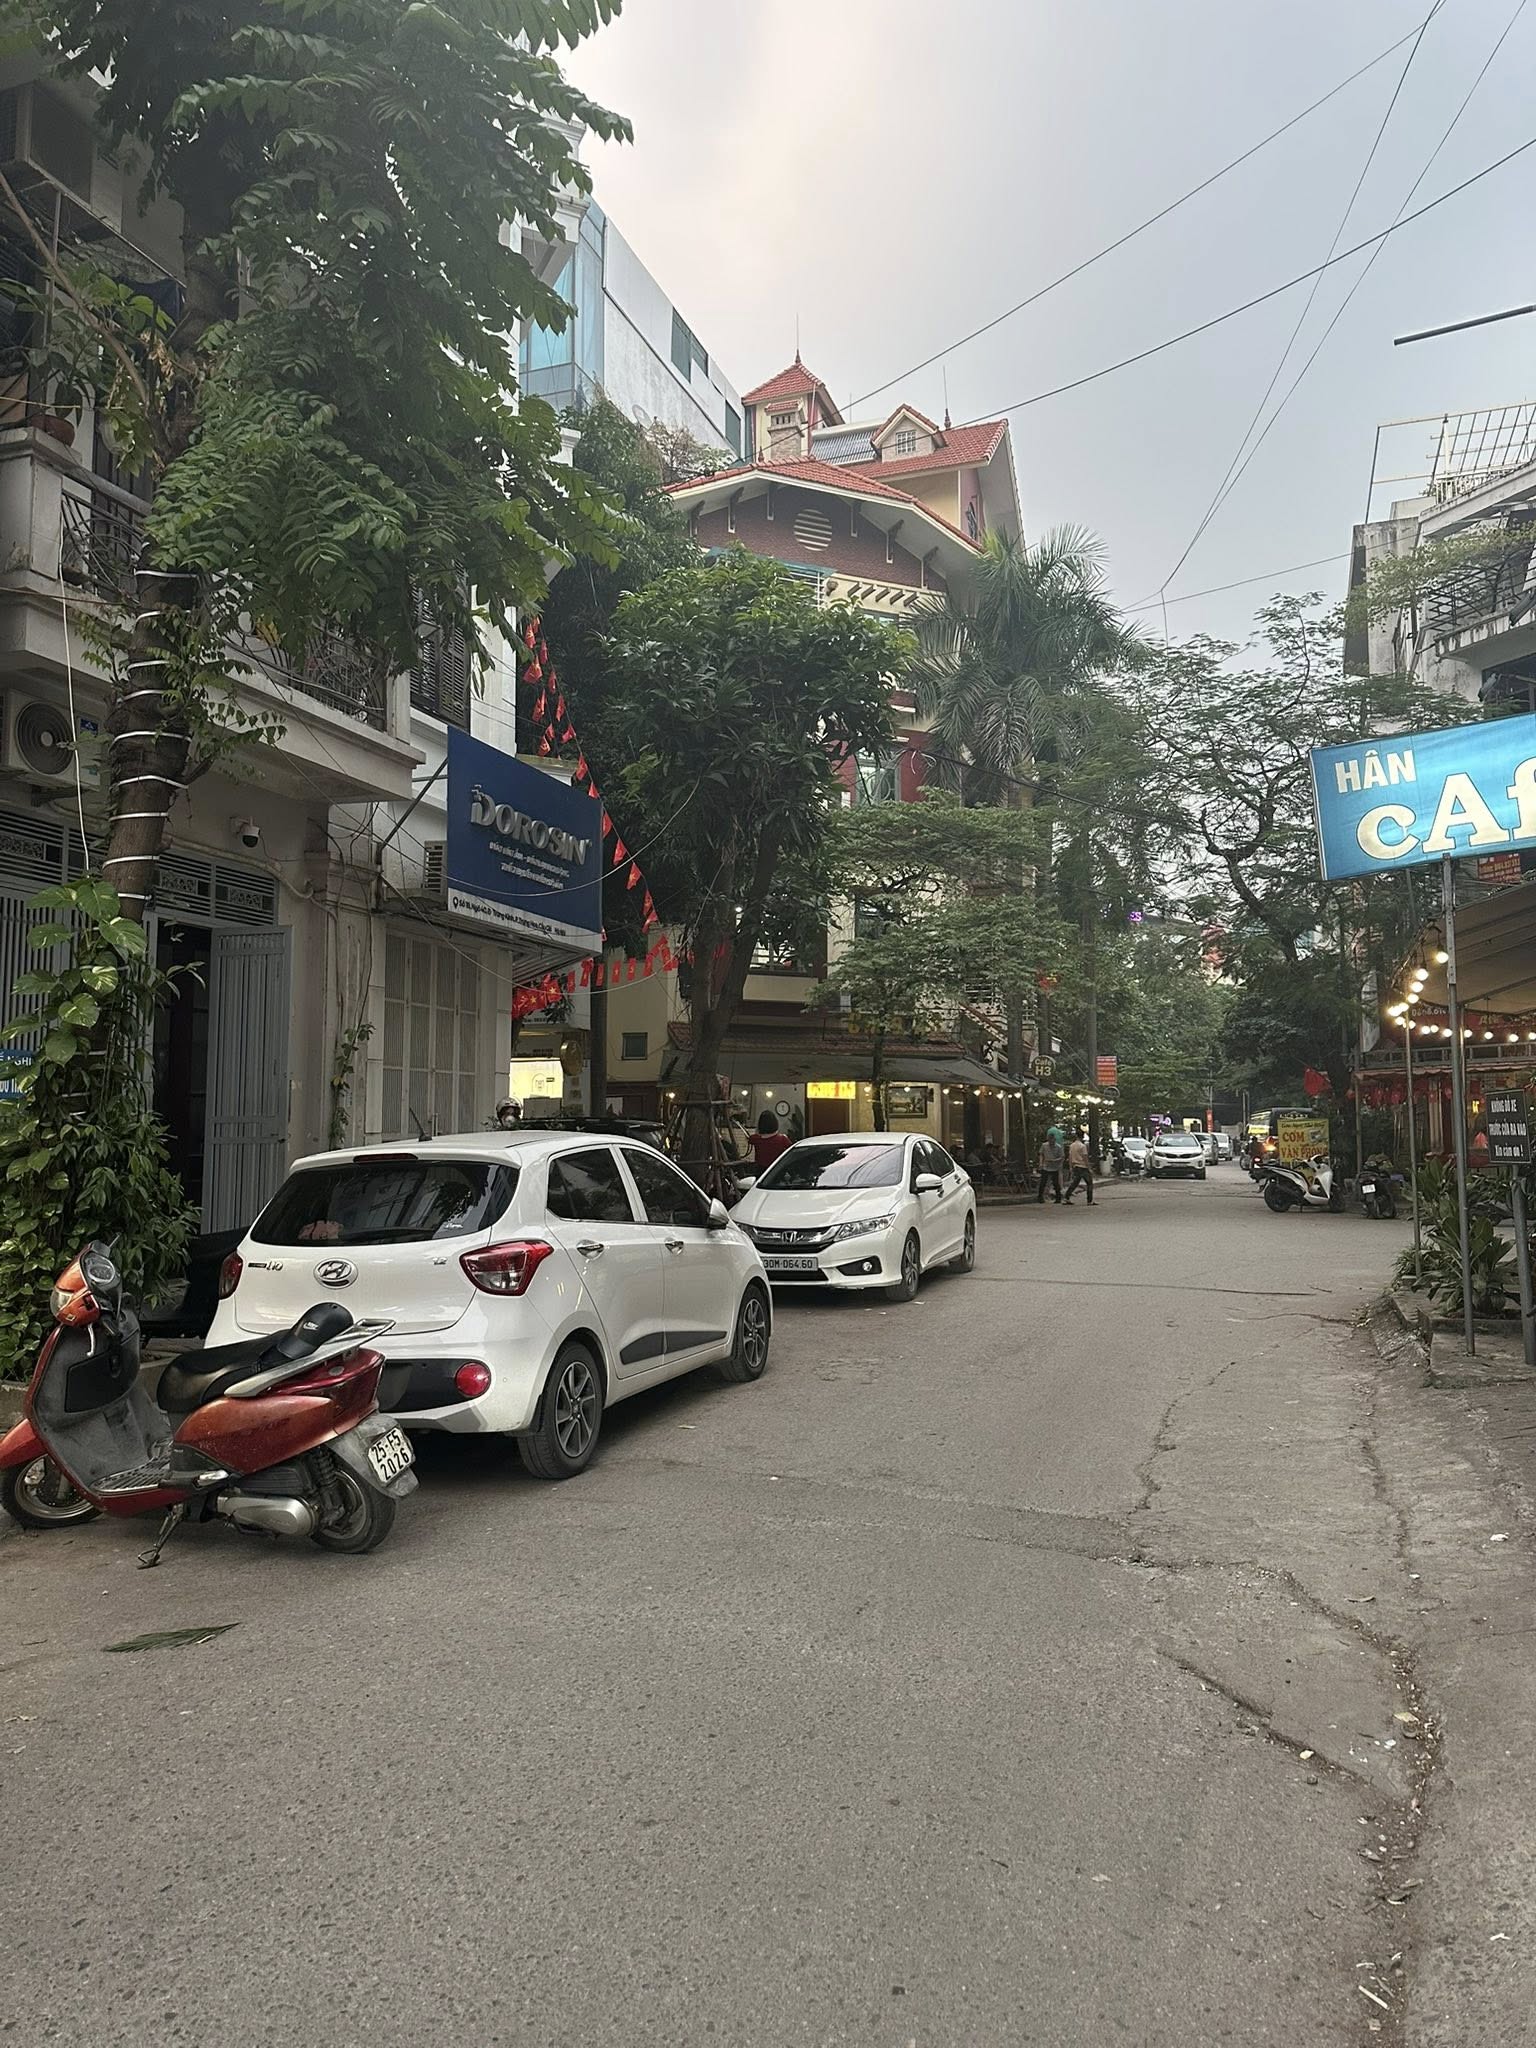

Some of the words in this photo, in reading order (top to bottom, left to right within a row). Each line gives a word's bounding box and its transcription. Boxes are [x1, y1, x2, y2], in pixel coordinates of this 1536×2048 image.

[1335, 750, 1417, 793] HÂN
[471, 784, 586, 865] DOROSIN
[1035, 1066, 1052, 1076] H3
[1510, 1099, 1517, 1112] XE
[1282, 1130, 1305, 1143] CƠM
[380, 1447, 410, 1481] 2026
